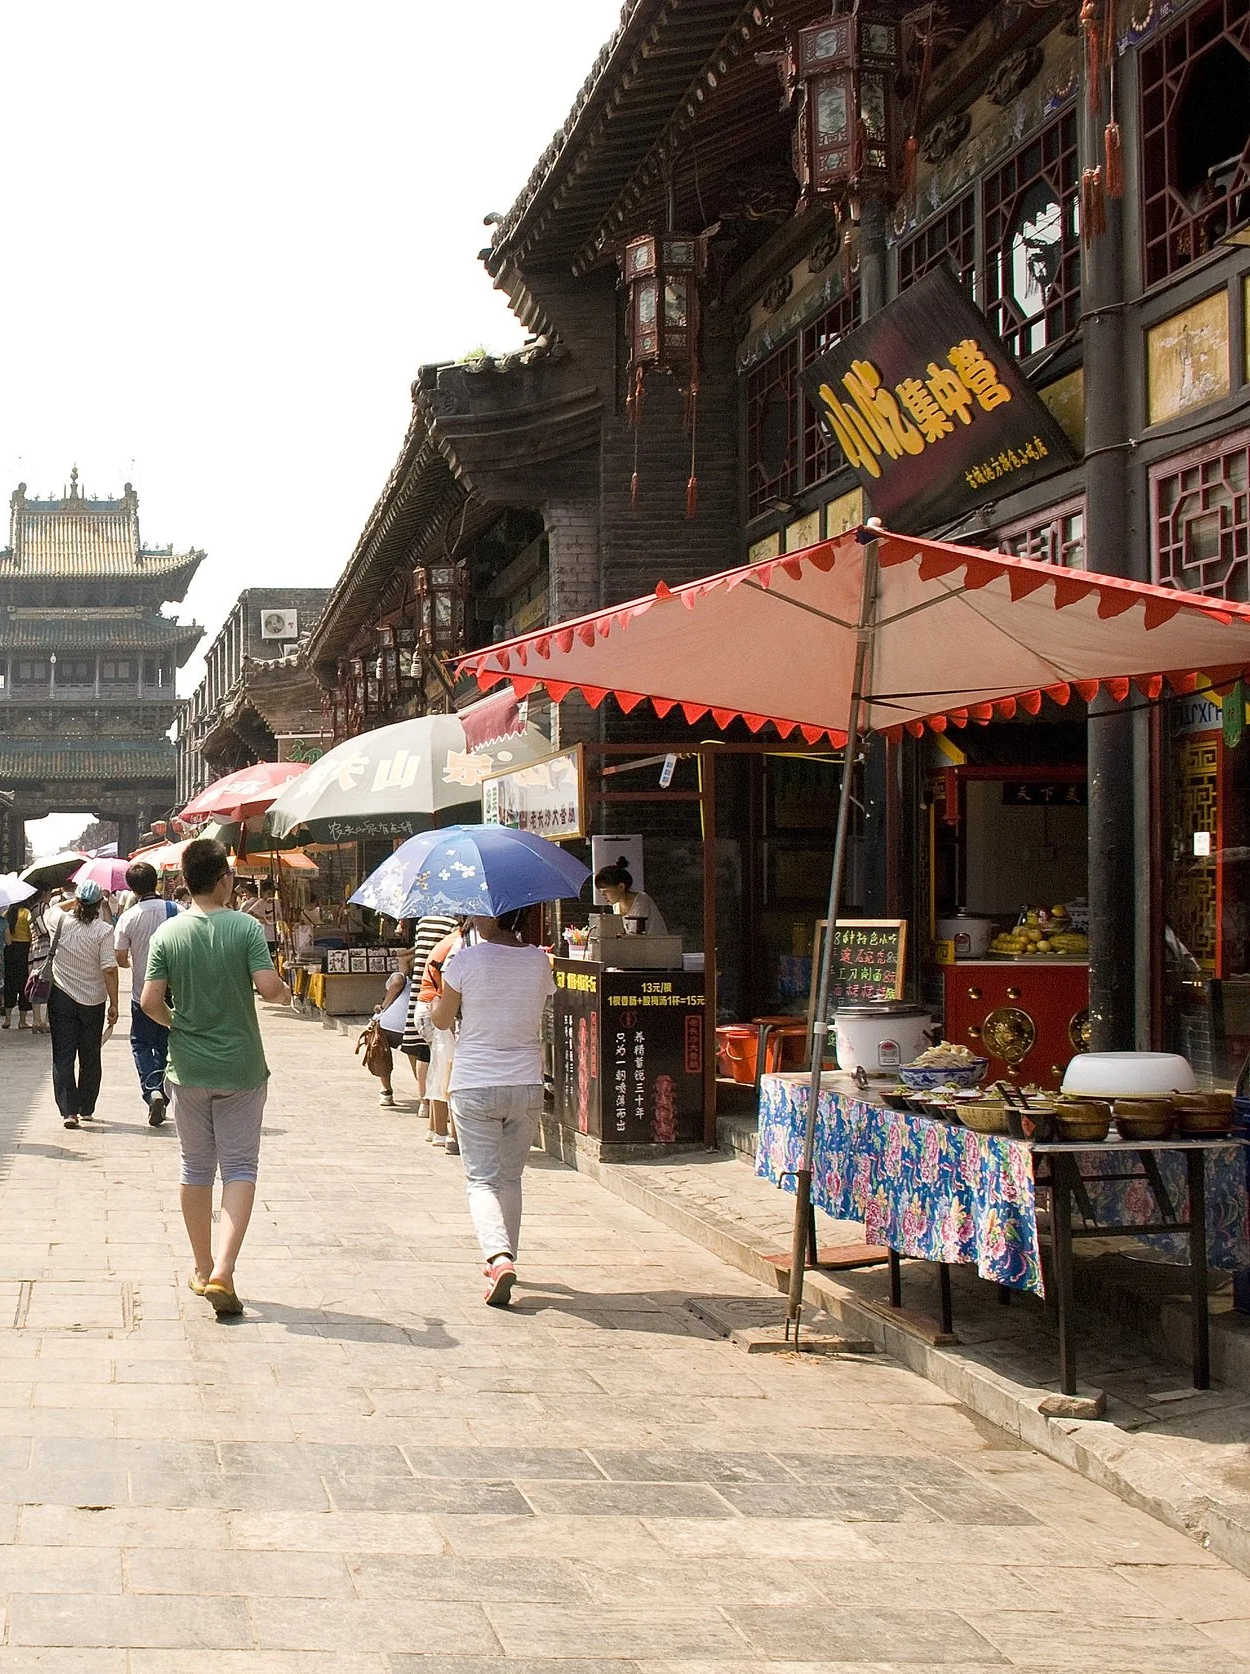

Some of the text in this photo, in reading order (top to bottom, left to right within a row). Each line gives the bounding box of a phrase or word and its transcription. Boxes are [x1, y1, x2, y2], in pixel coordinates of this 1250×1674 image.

[818, 338, 1012, 479] 小吃集中营
[328, 819, 413, 841] 农夫山泉有点甜
[634, 1031, 646, 1120] 养精蓄锐三十年
